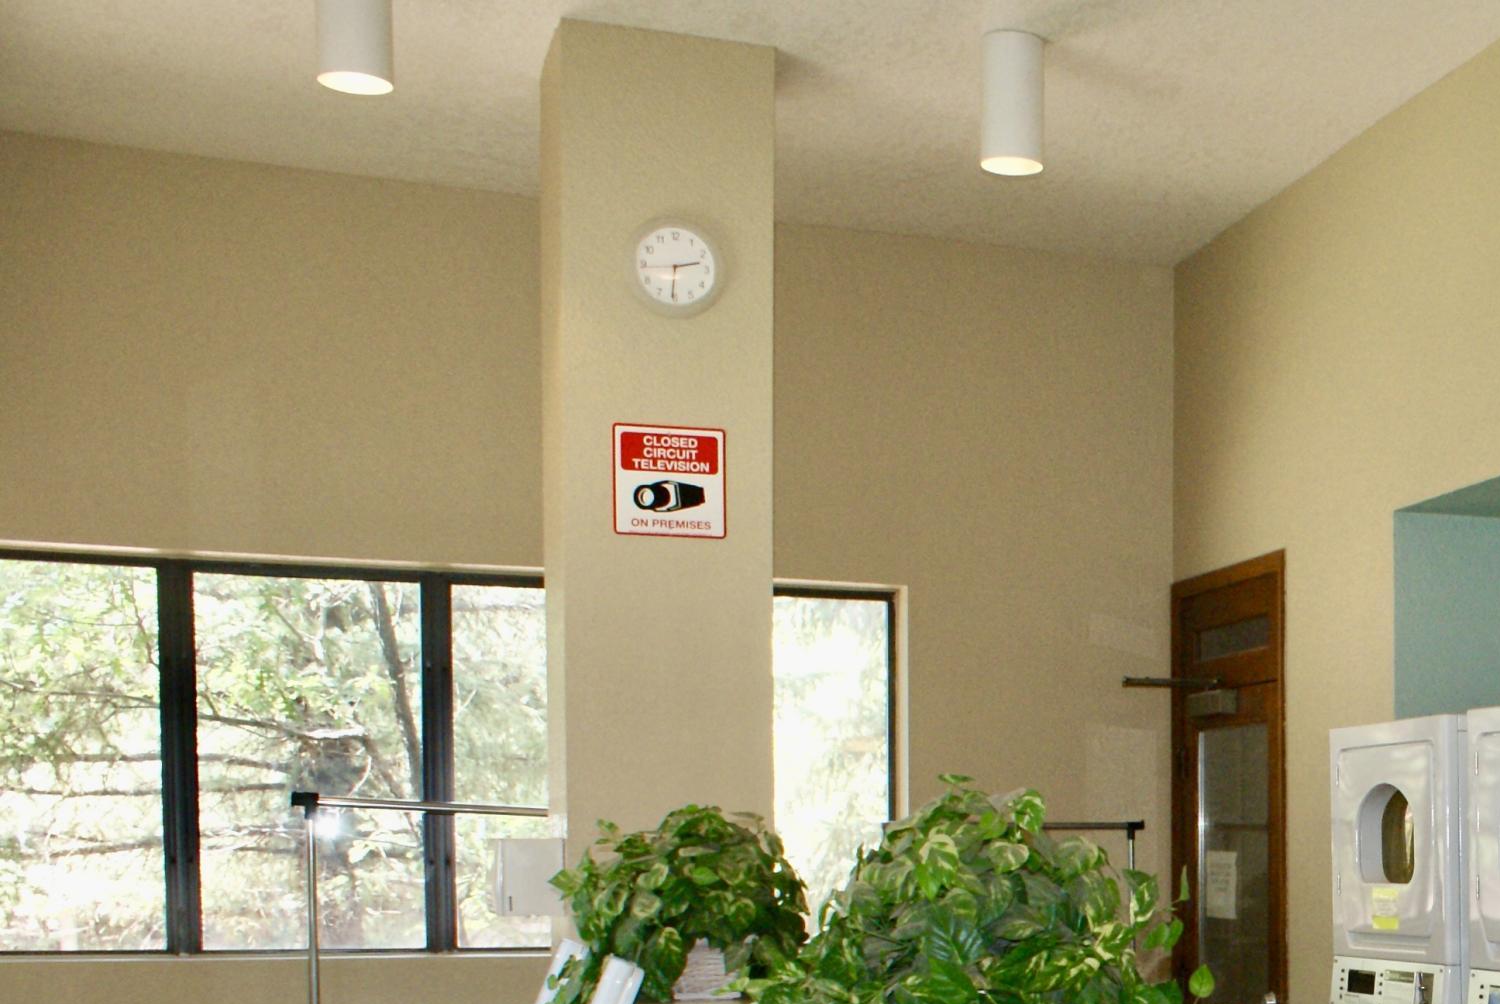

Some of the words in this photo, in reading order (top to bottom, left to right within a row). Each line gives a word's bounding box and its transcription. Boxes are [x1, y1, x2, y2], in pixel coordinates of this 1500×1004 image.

[642, 435, 698, 448] CLOSED
[642, 447, 699, 460] CIRCUIT
[631, 458, 710, 473] TELEVISION
[631, 518, 649, 528] ON
[651, 519, 712, 530] PREMISES
